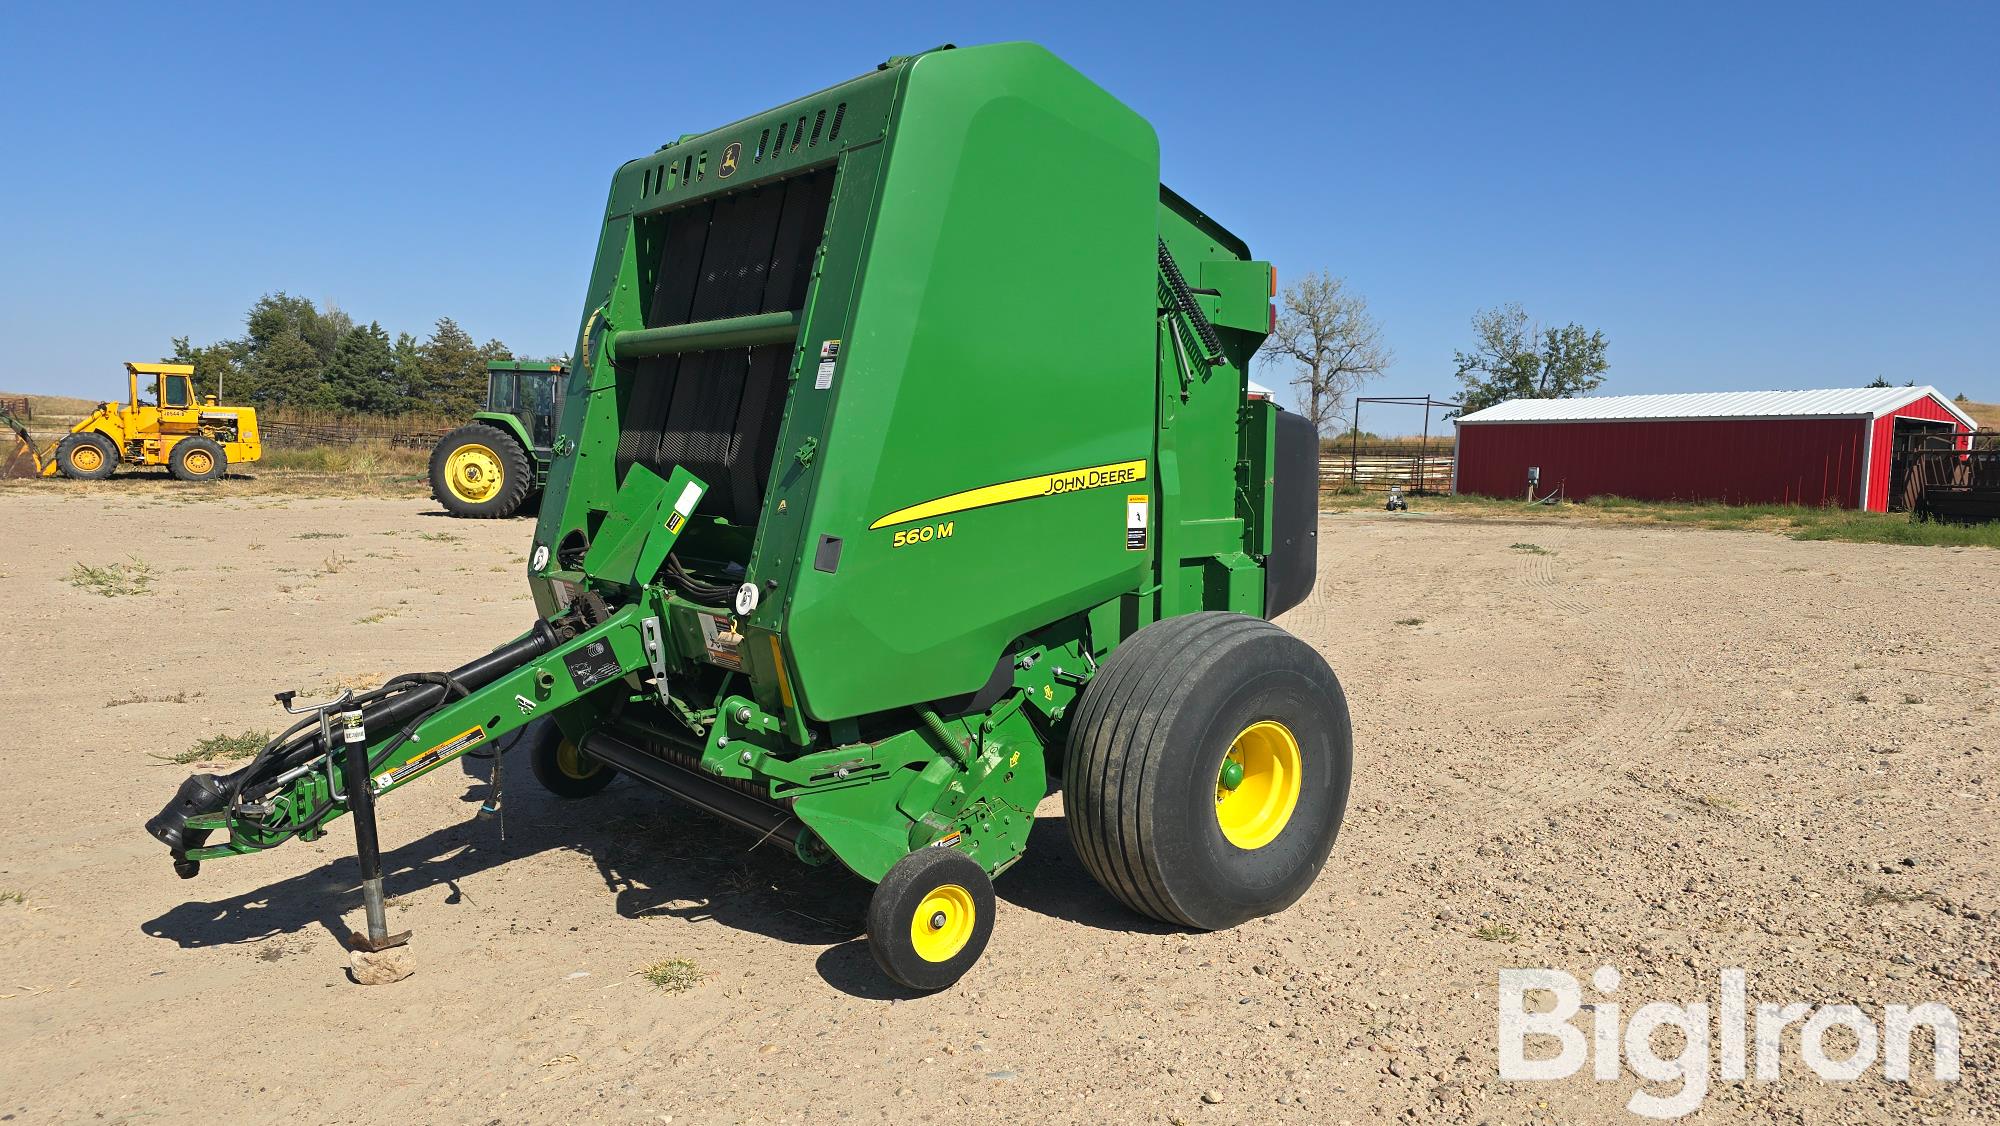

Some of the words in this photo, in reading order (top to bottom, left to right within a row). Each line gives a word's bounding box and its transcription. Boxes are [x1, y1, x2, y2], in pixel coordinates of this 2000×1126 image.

[1044, 475, 1085, 493] JOHN
[1089, 468, 1136, 485] DEERE
[893, 526, 933, 548] 560
[936, 522, 954, 539] M
